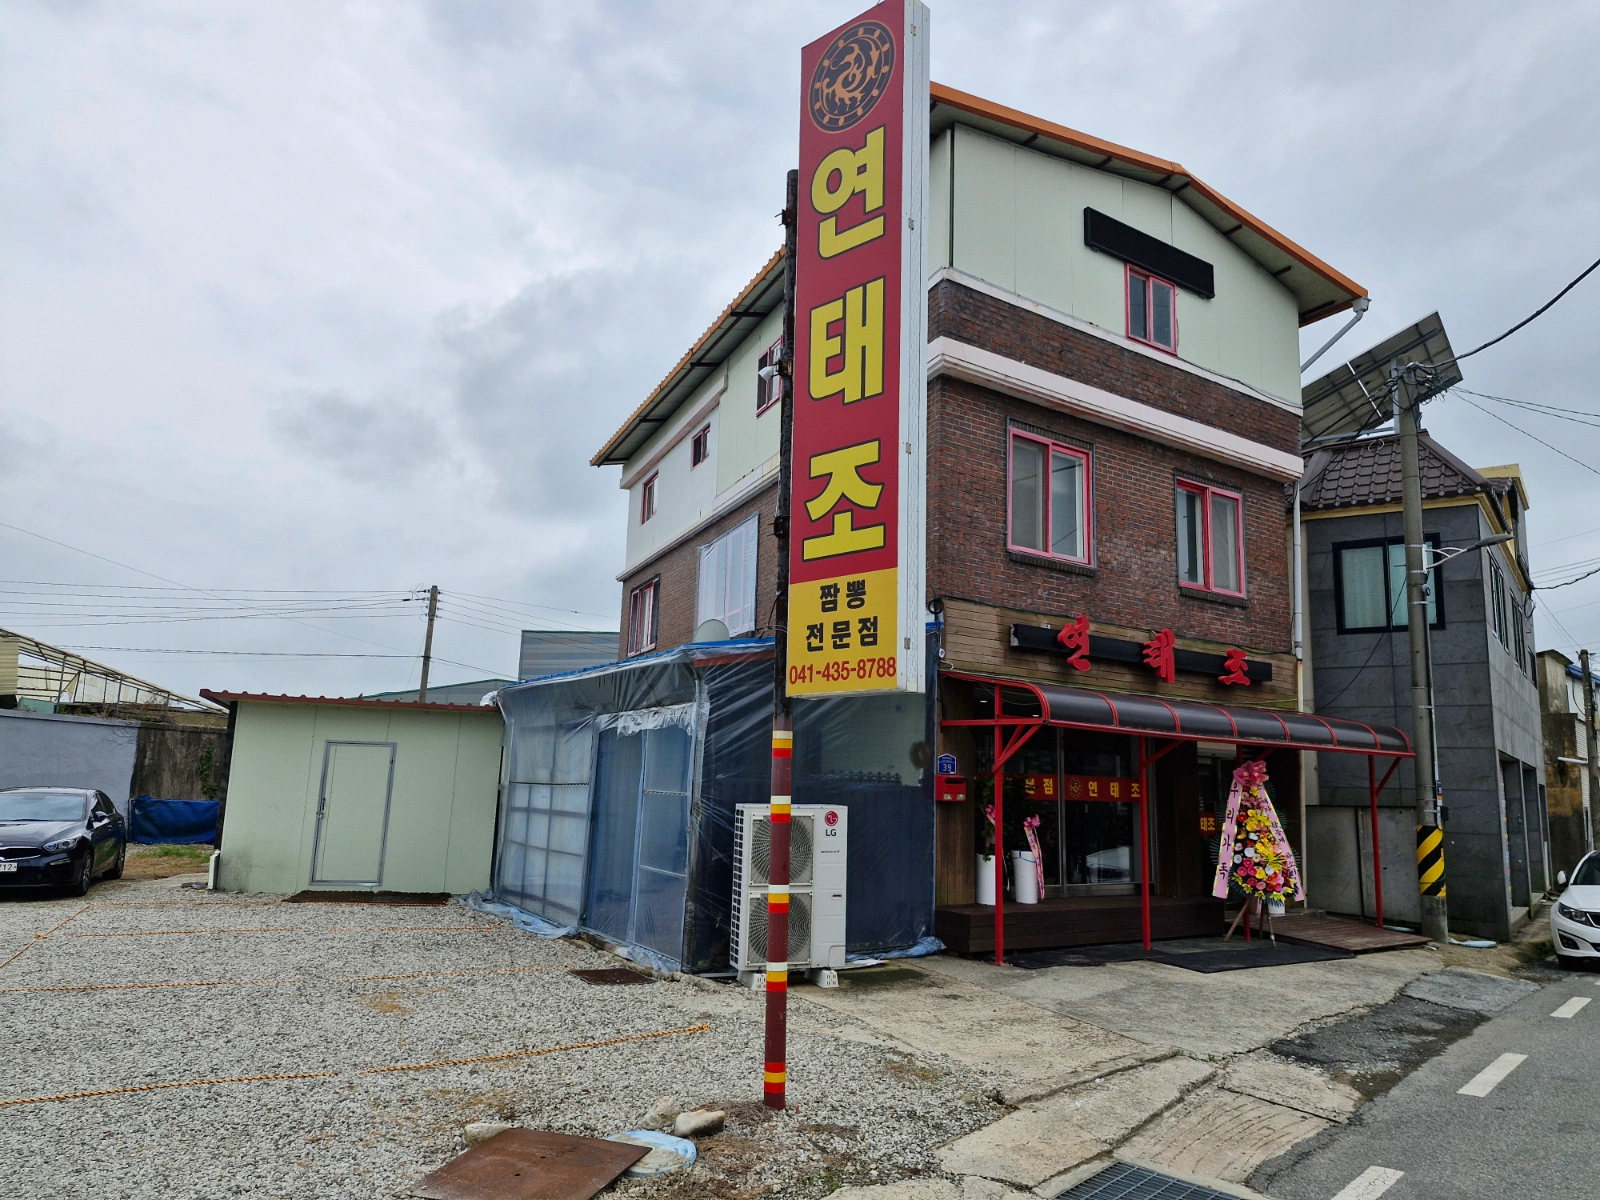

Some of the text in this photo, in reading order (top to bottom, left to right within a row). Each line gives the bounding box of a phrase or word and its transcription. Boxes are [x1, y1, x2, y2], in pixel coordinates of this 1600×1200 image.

[803, 123, 886, 562] 연태조
[820, 579, 866, 612] 짬뽕
[806, 616, 878, 652] 전문점
[1057, 615, 1250, 686] 연태조
[789, 656, 897, 684] 041-435-8788
[943, 763, 952, 772] 39
[1088, 781, 1141, 798] 연태조
[825, 829, 837, 837] LG
